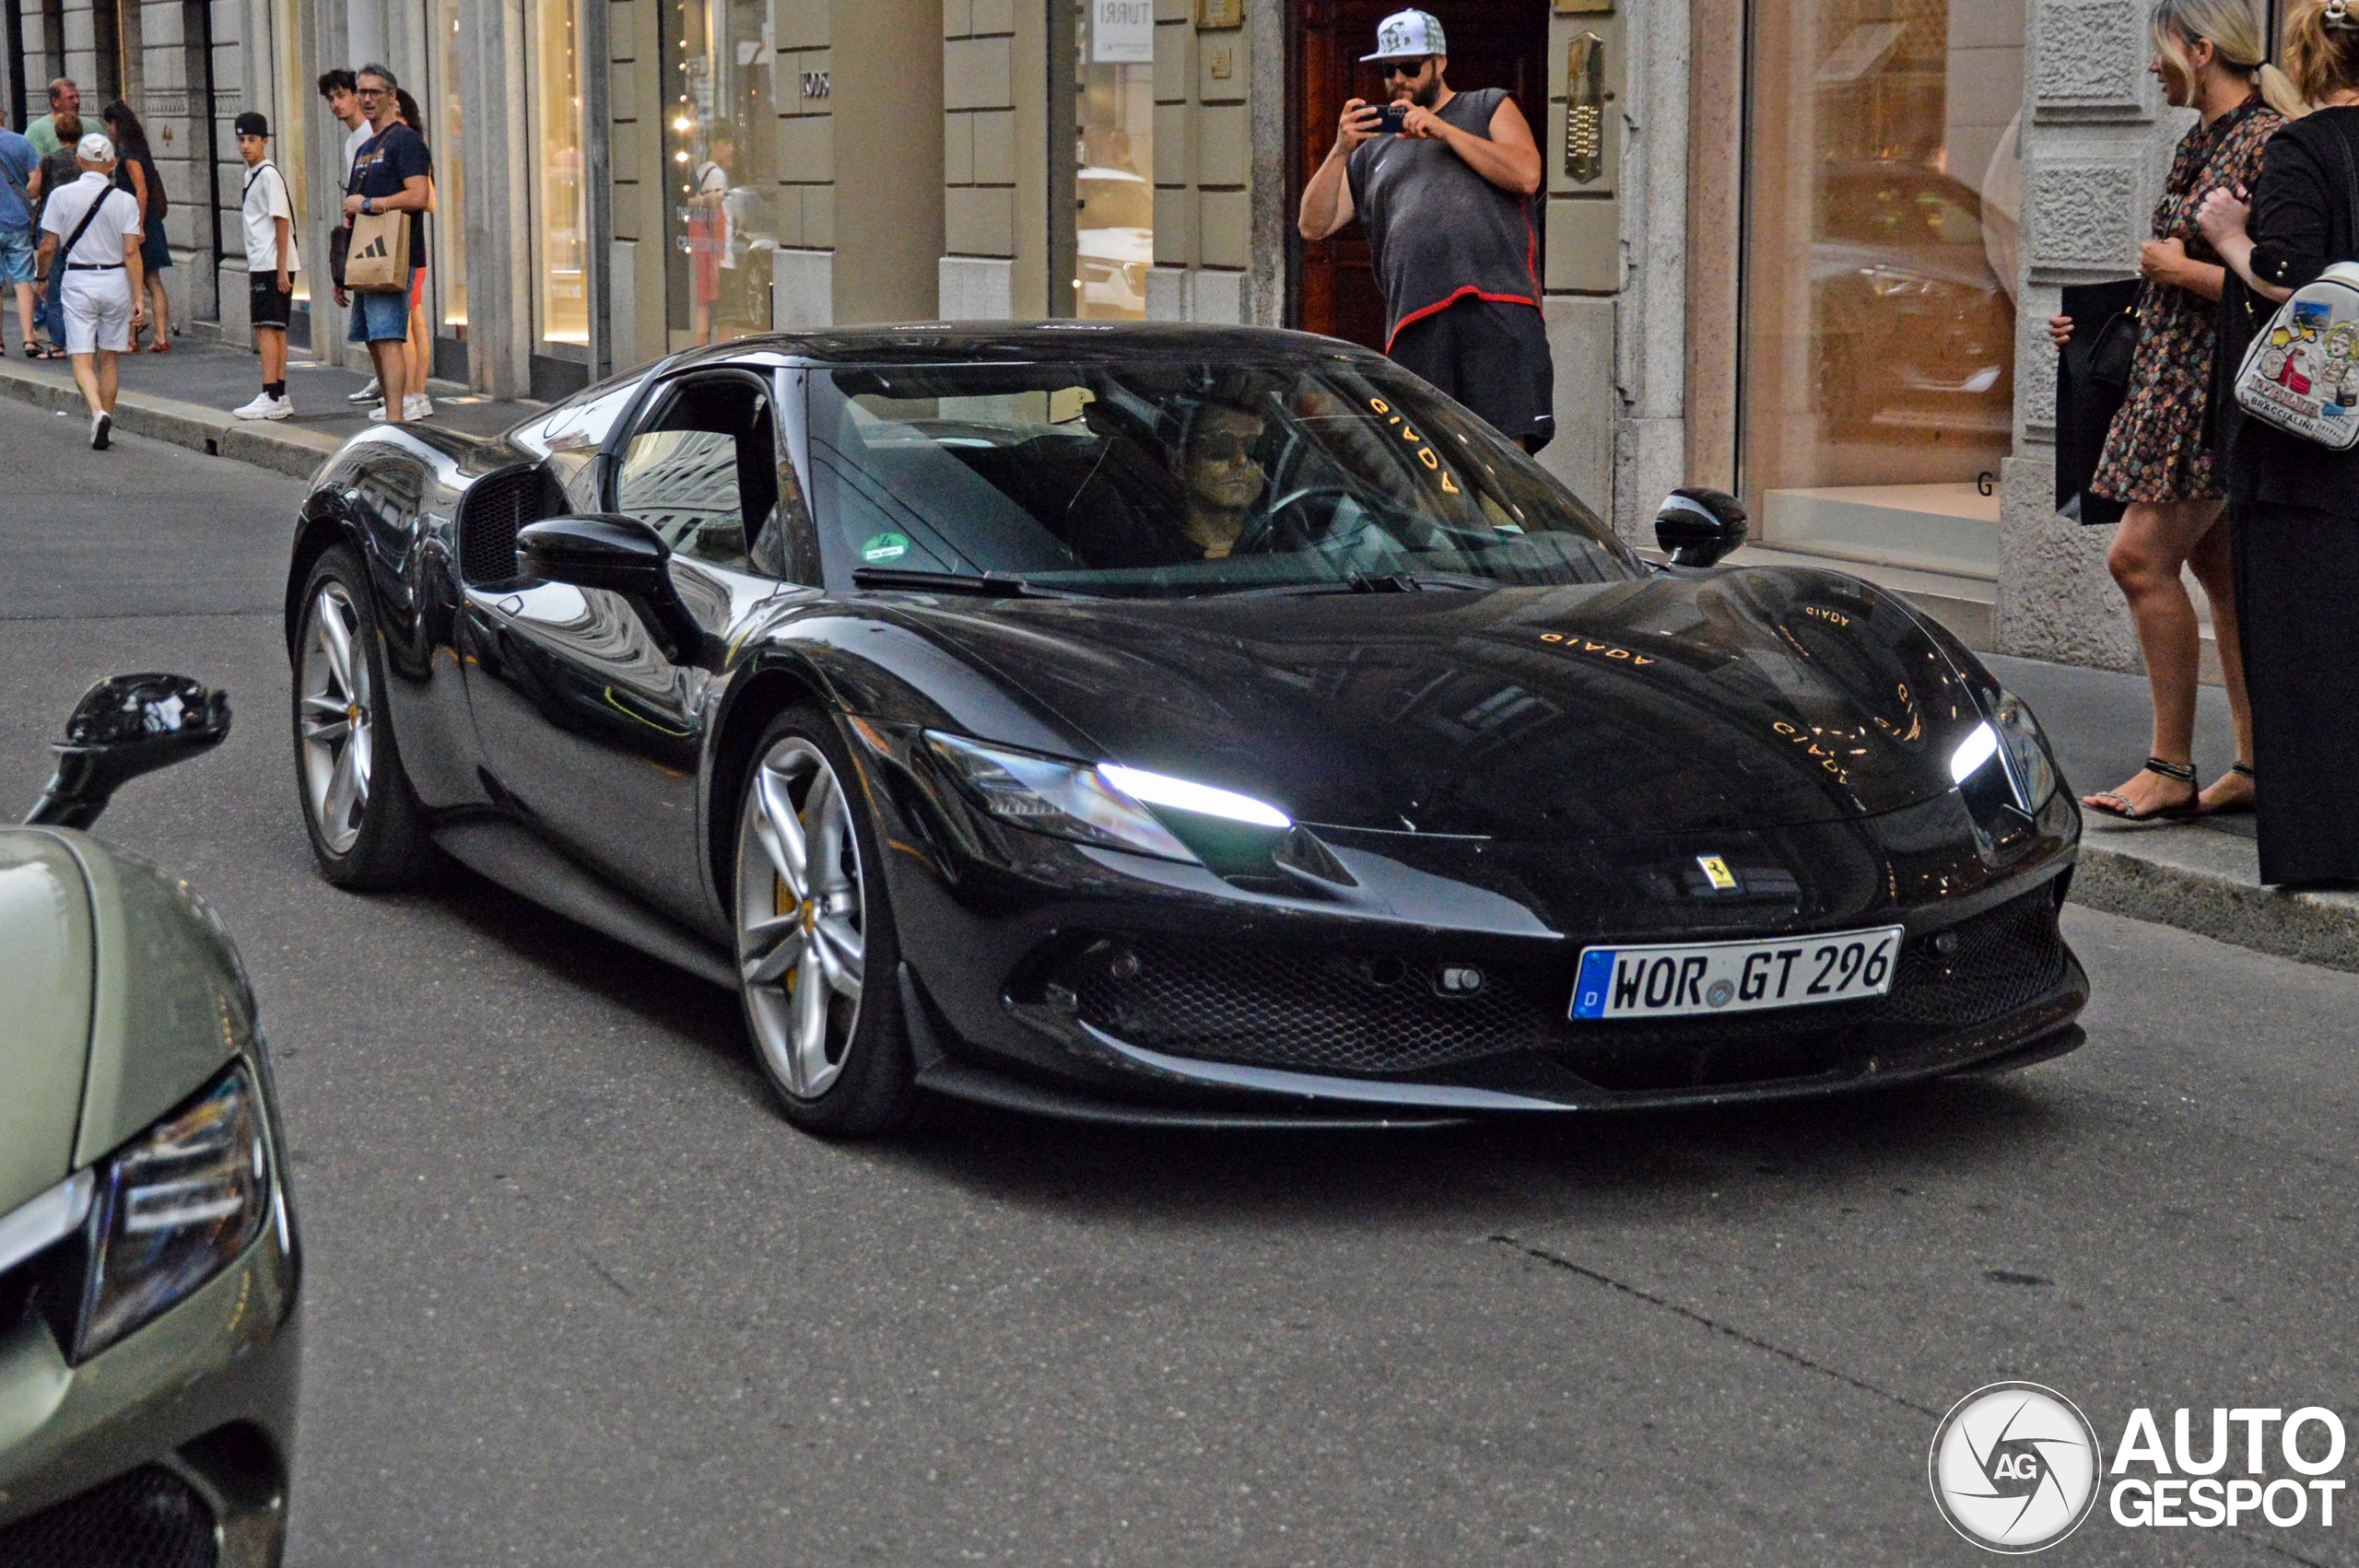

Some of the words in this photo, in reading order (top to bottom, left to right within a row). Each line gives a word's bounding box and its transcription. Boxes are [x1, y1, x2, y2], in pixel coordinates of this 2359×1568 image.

[2250, 396, 2314, 431] BRACCIALINI
[1614, 955, 1708, 1010] WOR
[1739, 948, 1802, 1001] GT
[1807, 939, 1891, 995] 296
[1584, 990, 1598, 1007] D
